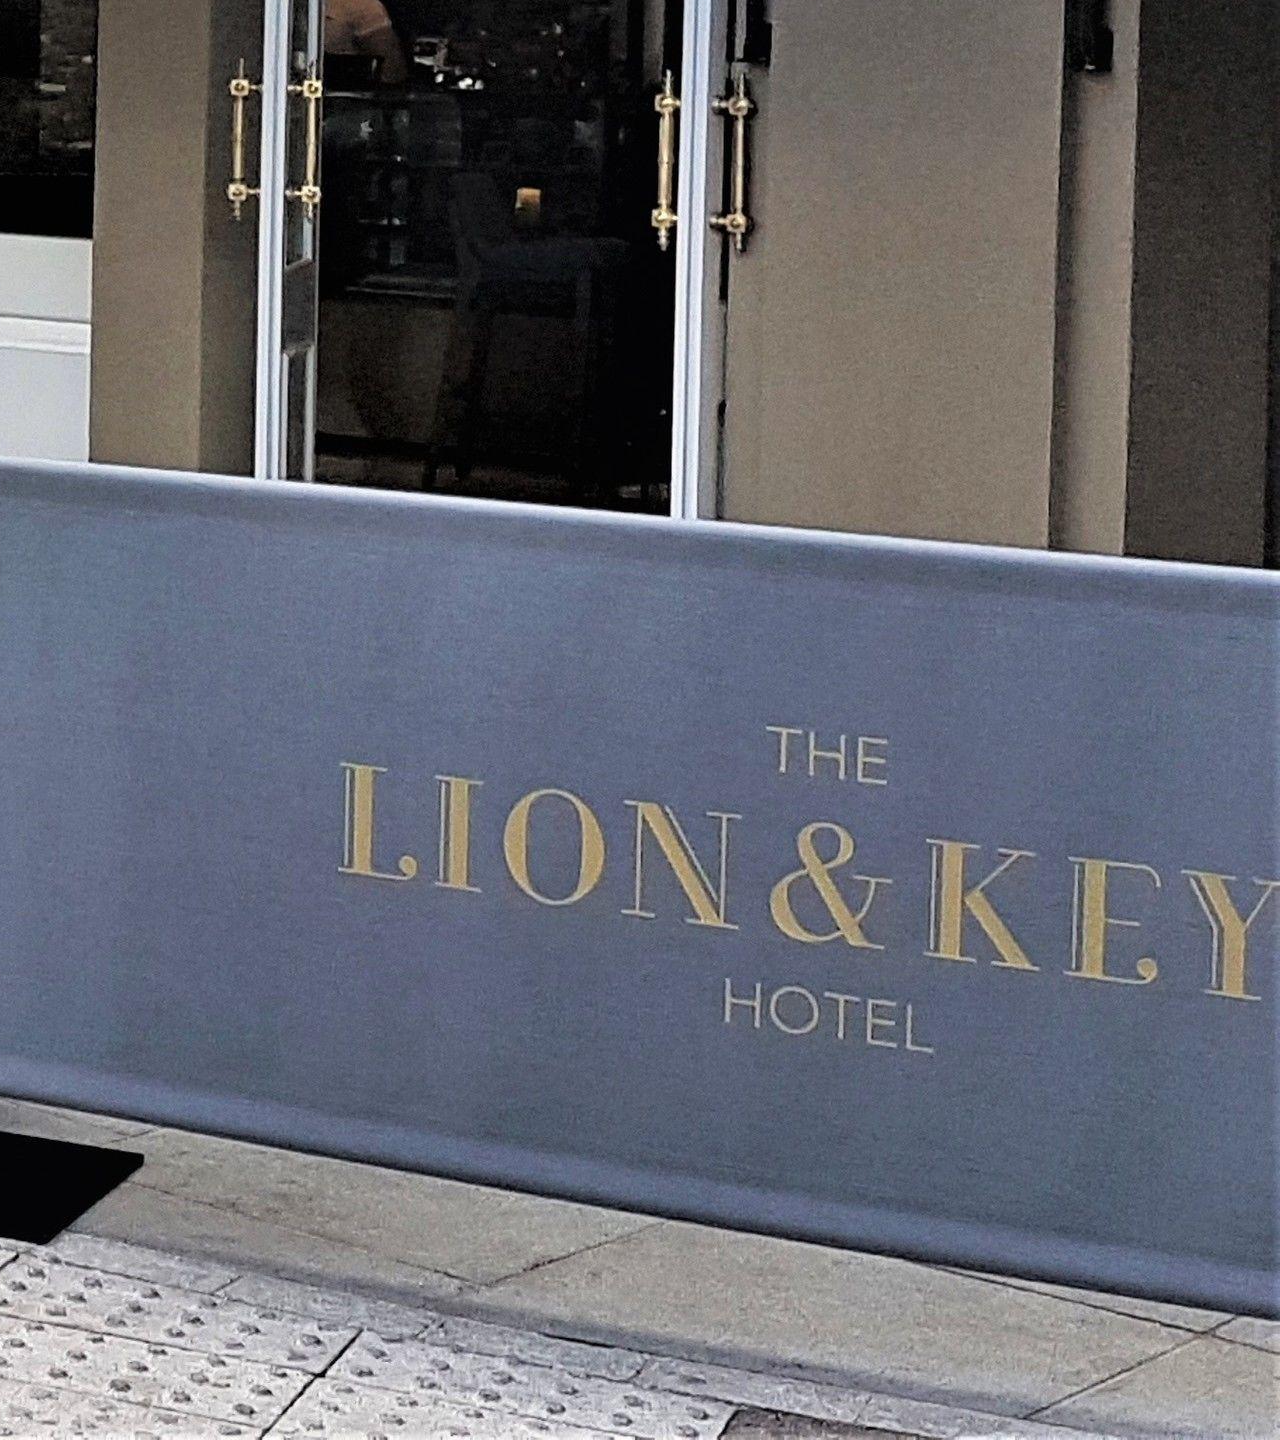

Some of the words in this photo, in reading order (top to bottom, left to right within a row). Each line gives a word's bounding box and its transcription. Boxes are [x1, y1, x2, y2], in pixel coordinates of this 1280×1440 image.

[765, 724, 889, 786] THE
[337, 761, 740, 930] LION
[769, 821, 894, 950] &
[922, 837, 1280, 1001] KEY
[722, 976, 935, 1054] HOTEL
